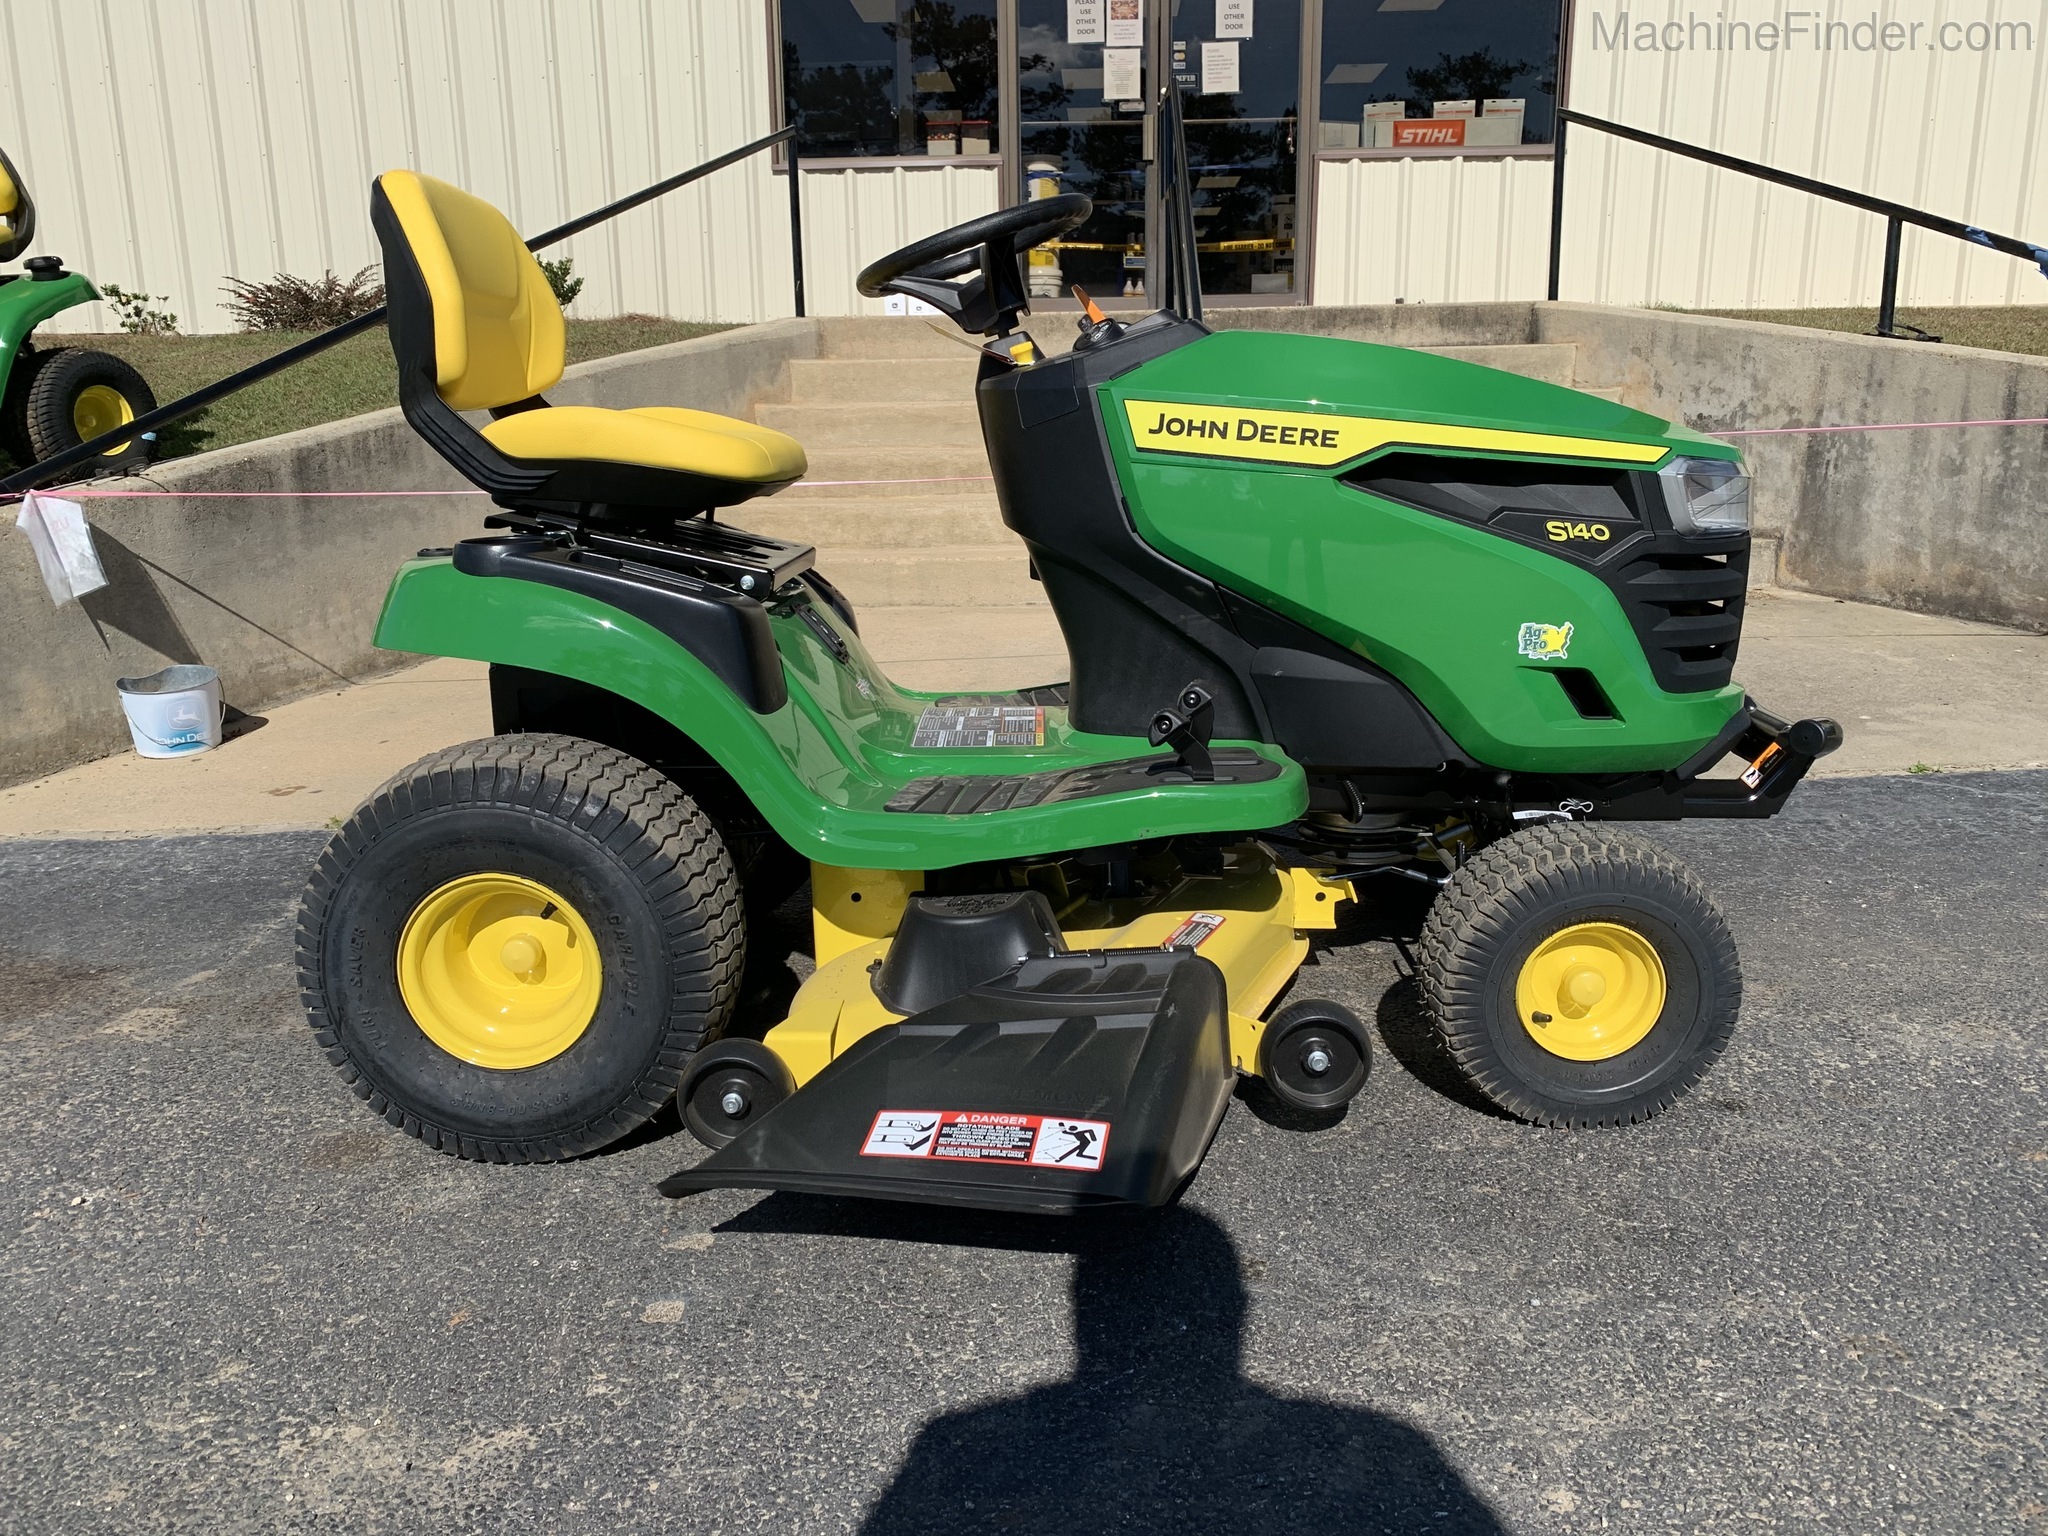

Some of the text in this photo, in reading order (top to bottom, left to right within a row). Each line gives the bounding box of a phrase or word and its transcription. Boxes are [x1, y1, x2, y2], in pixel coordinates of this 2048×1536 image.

[1399, 128, 1458, 143] STIHL
[1148, 413, 1340, 448] JOHN DEERE
[1546, 521, 1610, 542] S140
[1523, 639, 1547, 650] Pro
[970, 1114, 1027, 1124] DANGER
